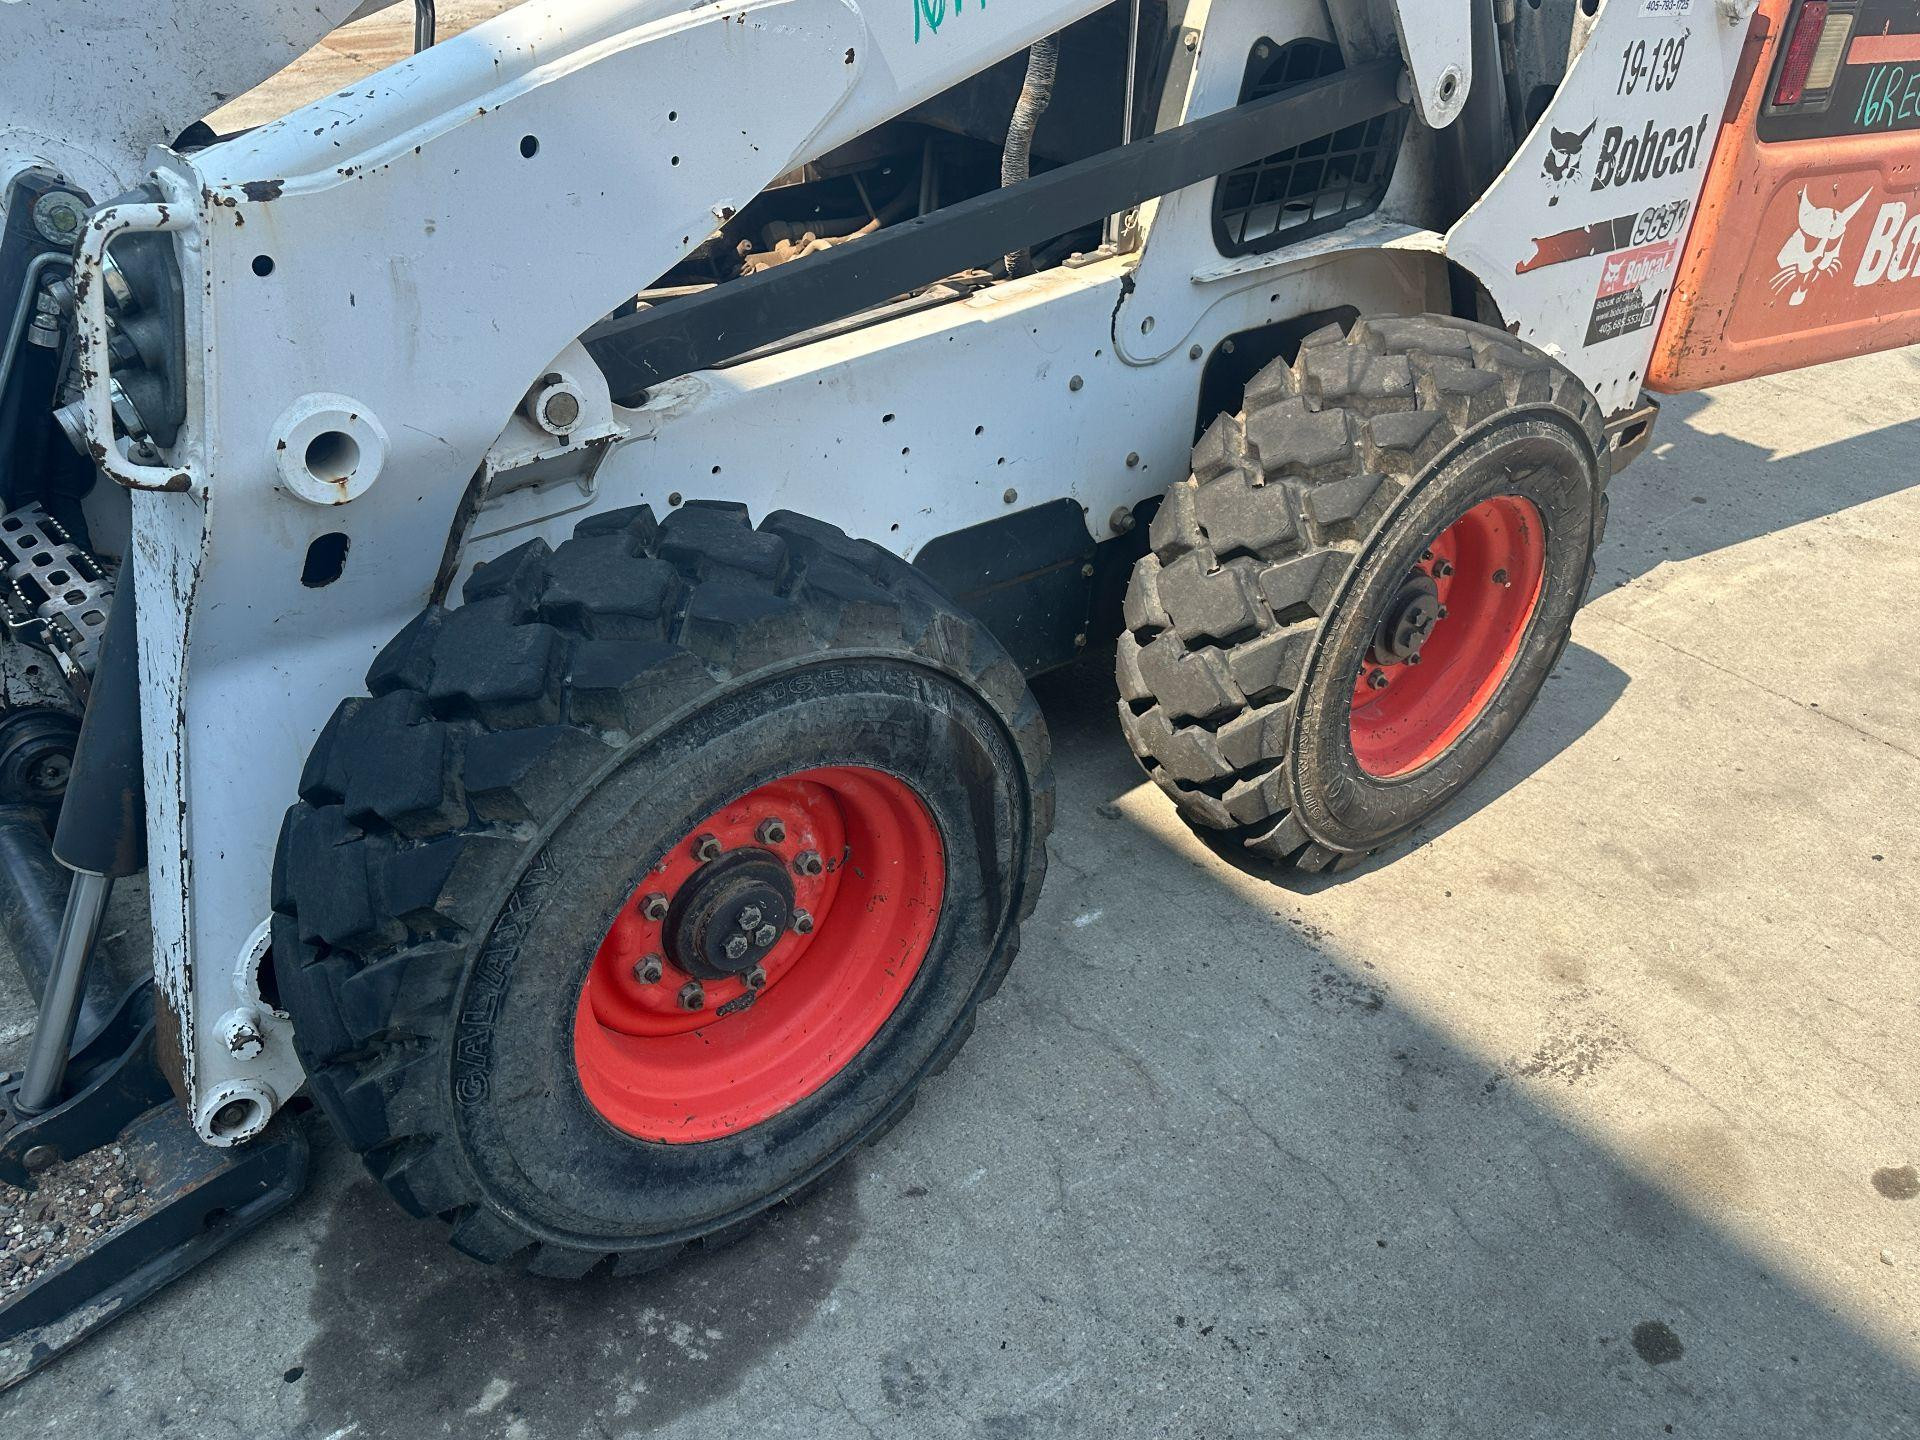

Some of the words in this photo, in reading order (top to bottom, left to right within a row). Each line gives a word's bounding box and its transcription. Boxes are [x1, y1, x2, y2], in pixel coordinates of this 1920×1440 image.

[1616, 37, 1686, 96] 19-139
[1590, 113, 1709, 192] Bobcat
[1633, 199, 1690, 247] S650
[1853, 202, 1920, 287] Bo
[1622, 253, 1671, 287] Bobcat
[456, 848, 562, 1106] GALAXY
